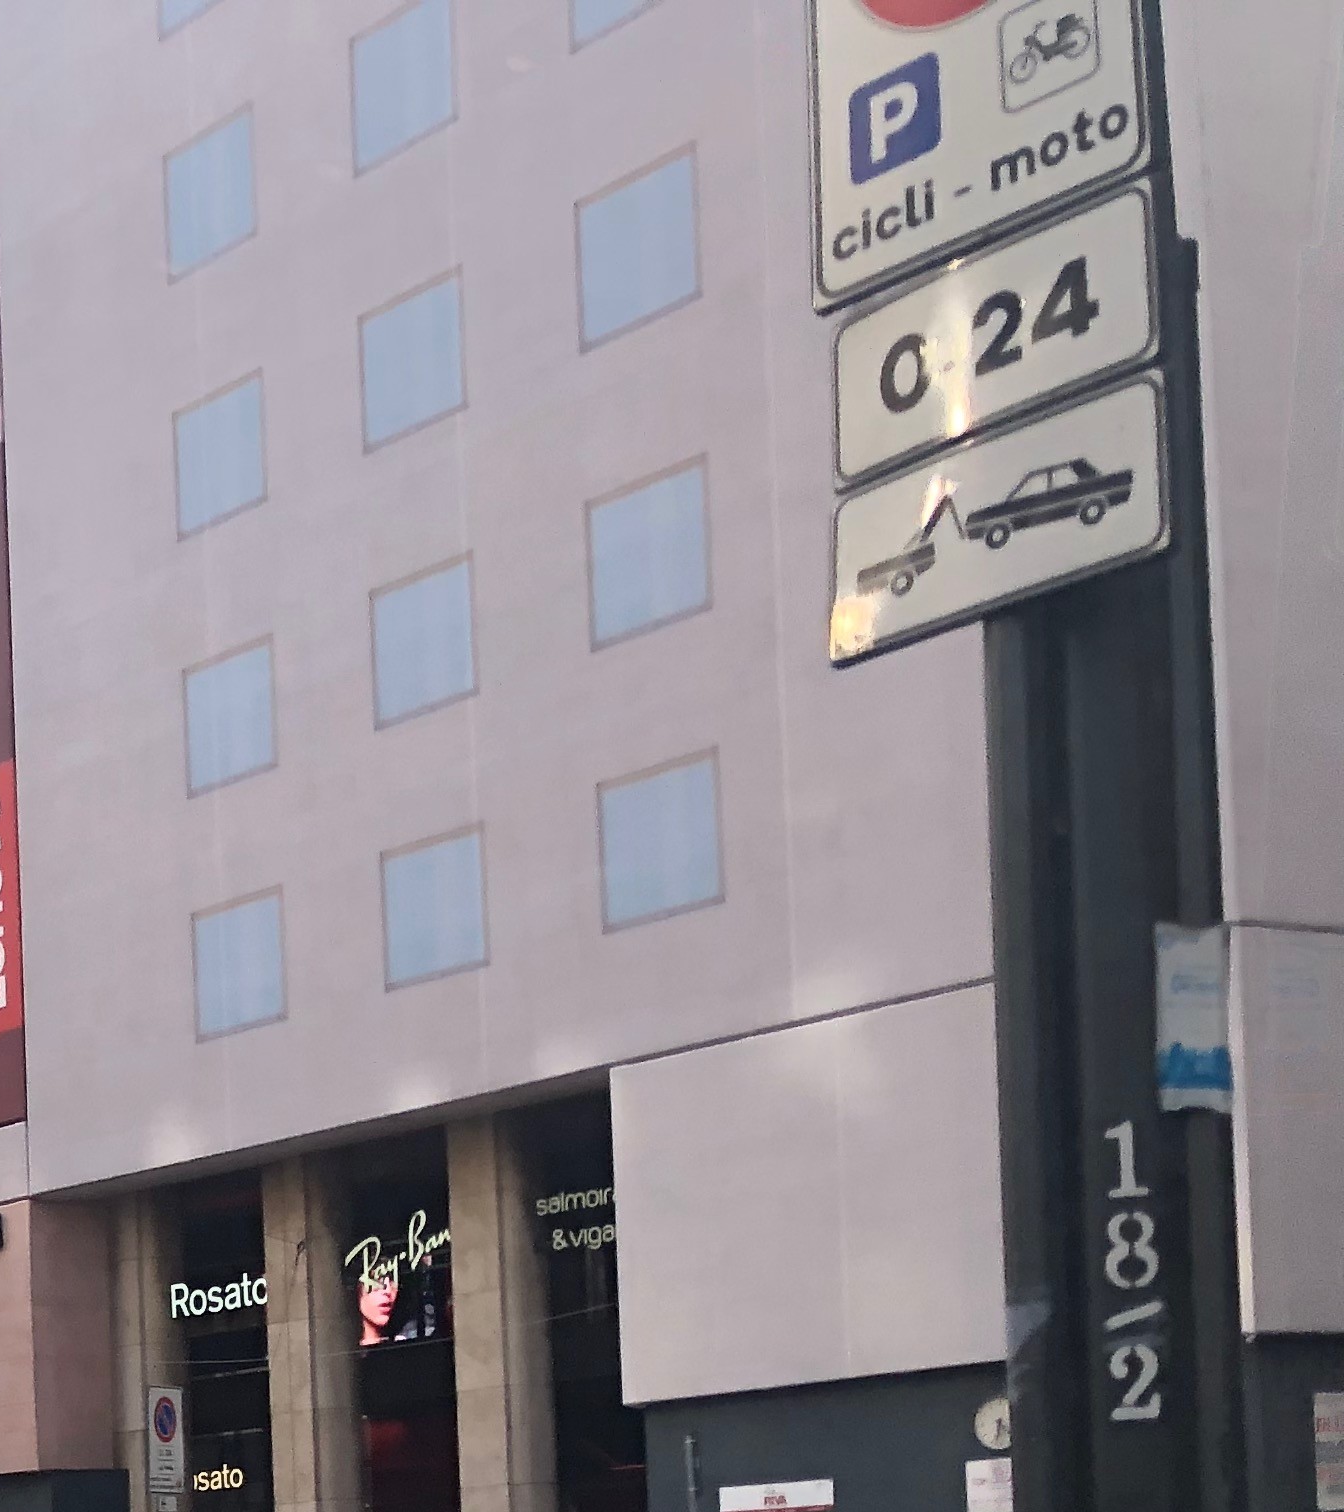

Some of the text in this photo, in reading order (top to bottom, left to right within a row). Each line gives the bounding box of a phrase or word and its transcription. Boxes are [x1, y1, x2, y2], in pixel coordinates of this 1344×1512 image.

[867, 80, 919, 165] P
[832, 180, 936, 261] cicli
[989, 102, 1130, 192] moto
[193, 1463, 244, 1492] sato
